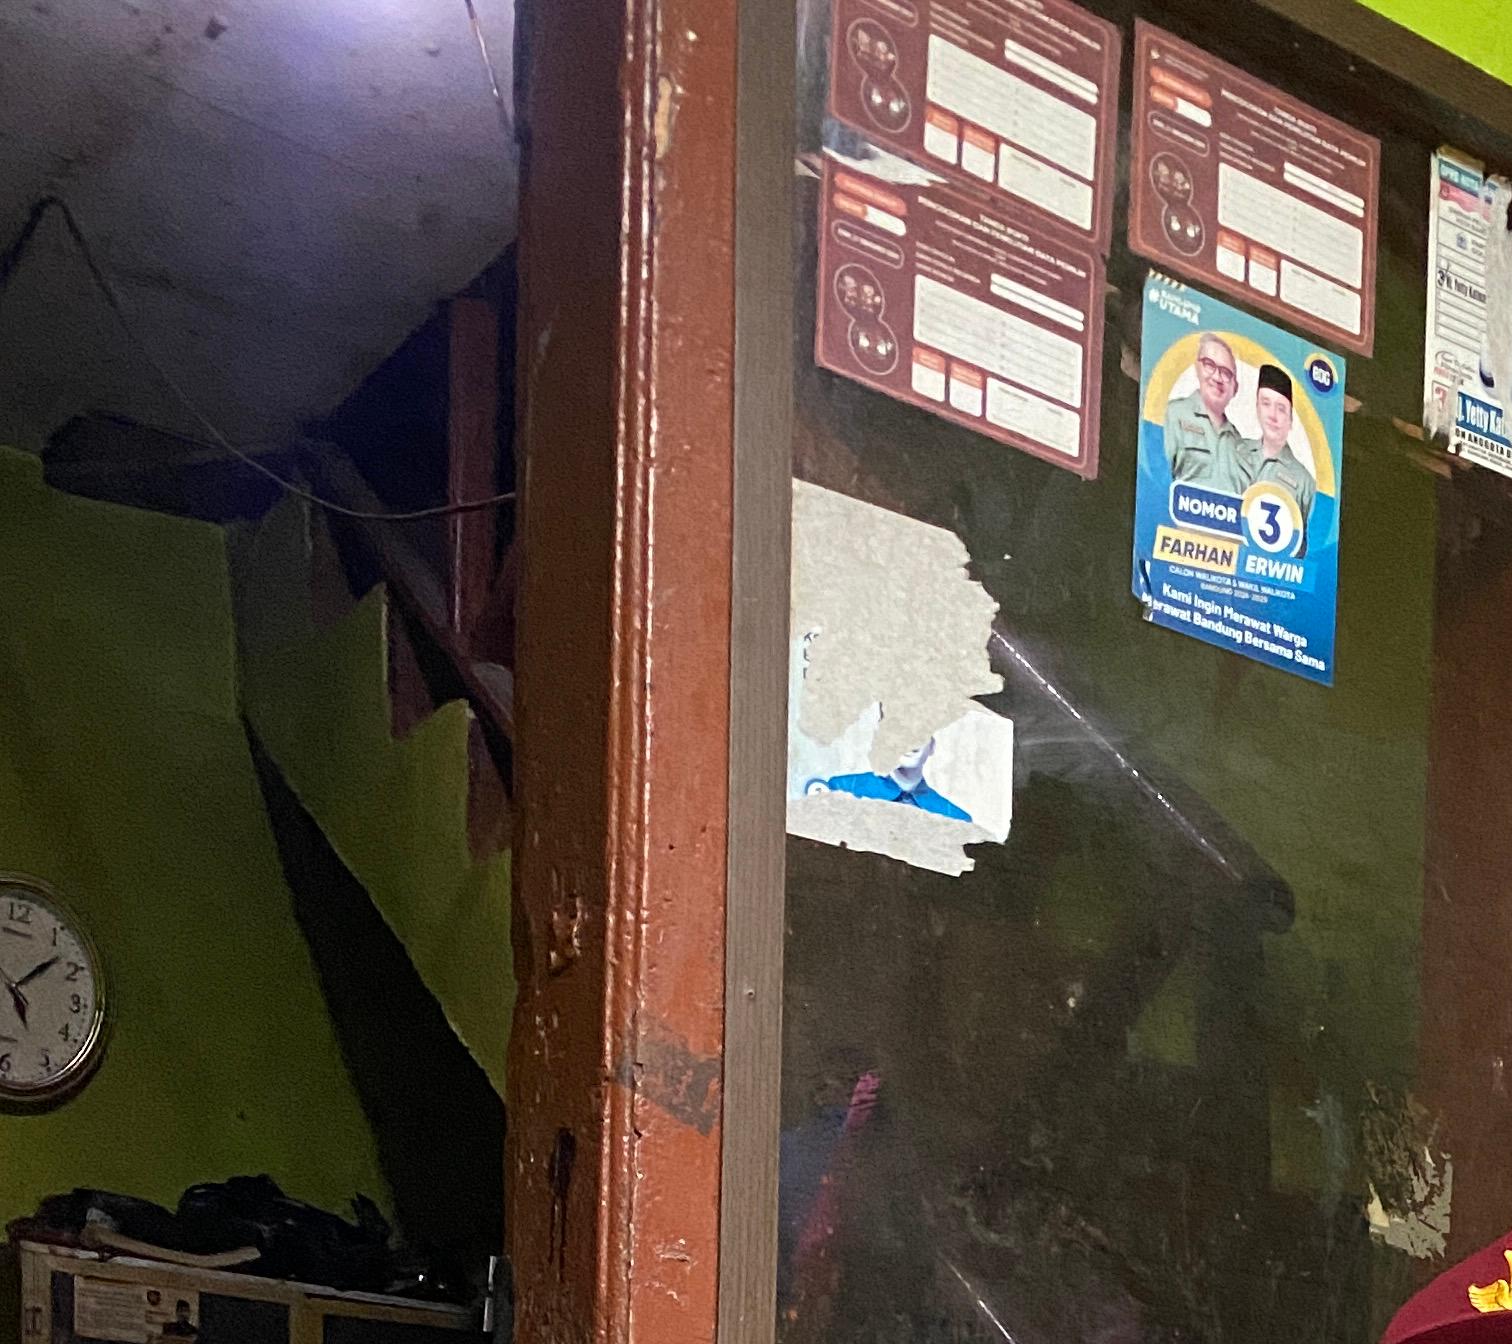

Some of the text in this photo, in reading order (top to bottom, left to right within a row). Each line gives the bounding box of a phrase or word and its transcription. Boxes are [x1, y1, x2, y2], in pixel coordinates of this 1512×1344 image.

[1160, 298, 1200, 326] UTAMA
[1178, 495, 1281, 545] NOMOR 3
[1160, 535, 1304, 583] FARHAN ERWIN
[1162, 582, 1307, 648] Kami Ingin Merawat Warga
[1193, 612, 1243, 644] Bandung
[1244, 631, 1294, 660] Bersama
[1295, 649, 1326, 671] Sama
[8, 902, 32, 925] 12
[66, 961, 81, 982] 2
[69, 994, 81, 1014] 3
[58, 1022, 69, 1042] 4
[0, 1053, 11, 1073] 6
